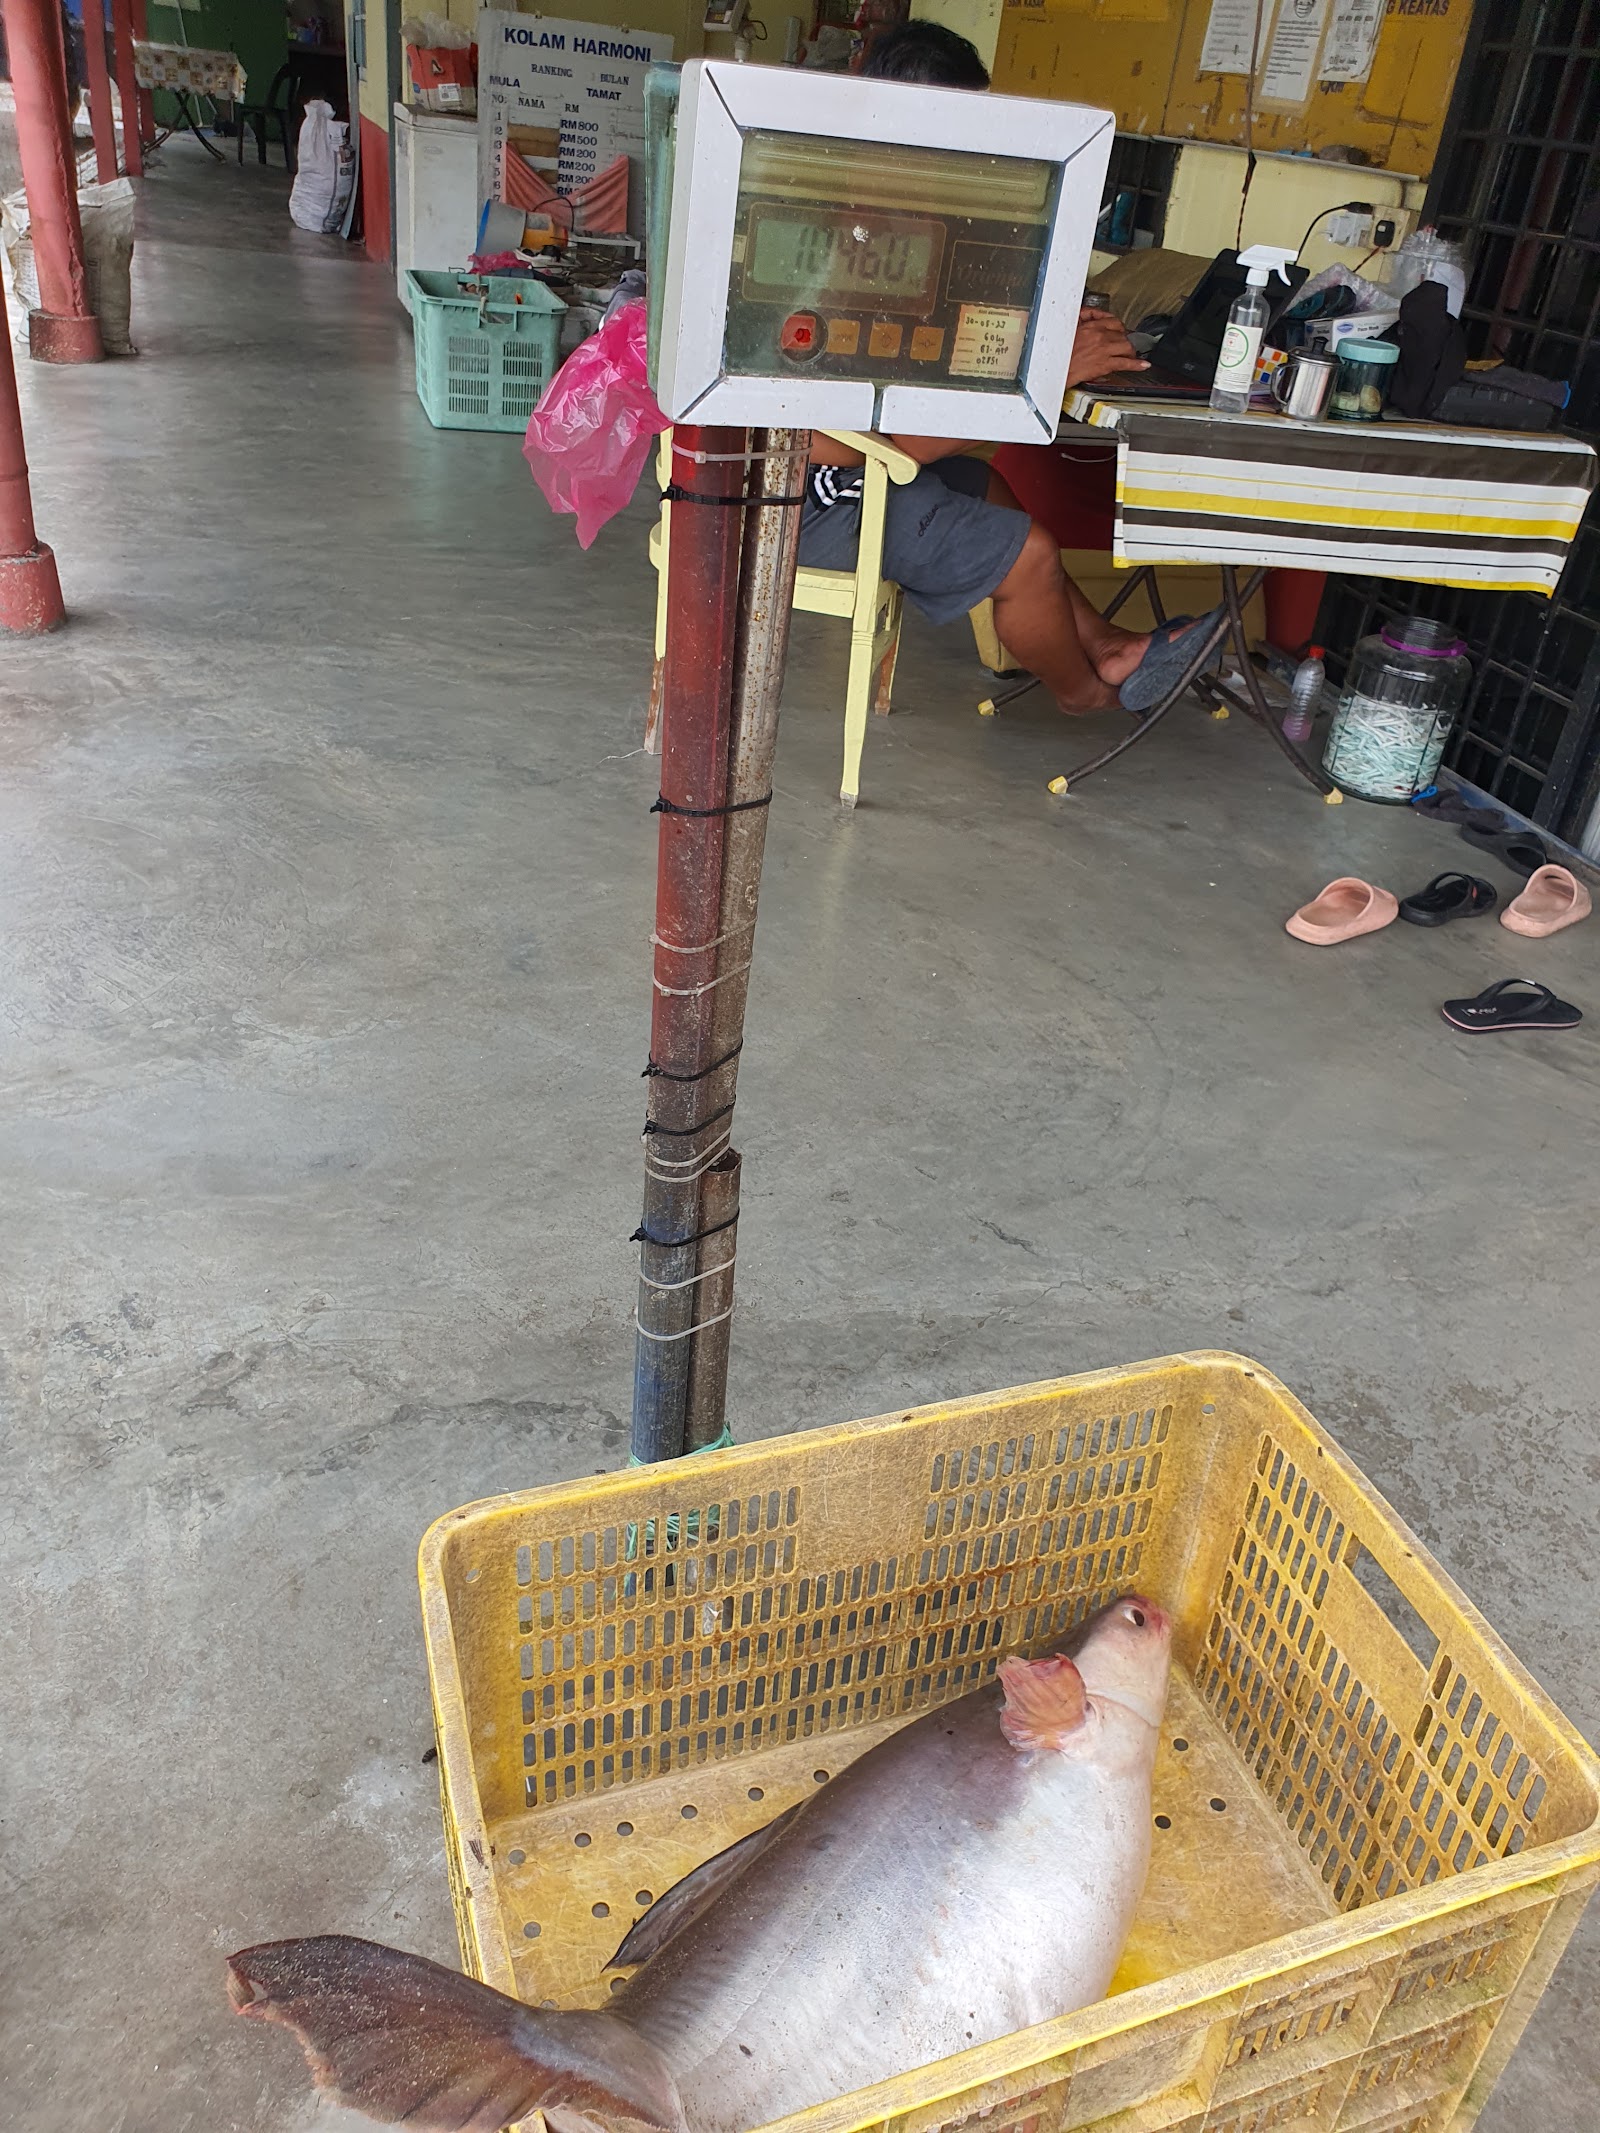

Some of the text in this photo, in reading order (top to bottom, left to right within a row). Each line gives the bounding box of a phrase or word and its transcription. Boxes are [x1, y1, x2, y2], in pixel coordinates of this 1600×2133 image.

[504, 28, 651, 62] KOLAM HARMONI
[531, 63, 630, 86] RANKING BULAN
[489, 75, 622, 101] MULA TAMAT
[518, 97, 545, 109] NAMA
[565, 103, 579, 113] RM
[496, 112, 502, 120] 1
[495, 126, 503, 135] 2
[494, 140, 502, 149] 3
[494, 154, 501, 162] 4
[494, 168, 501, 177] 5
[494, 181, 501, 189] 6
